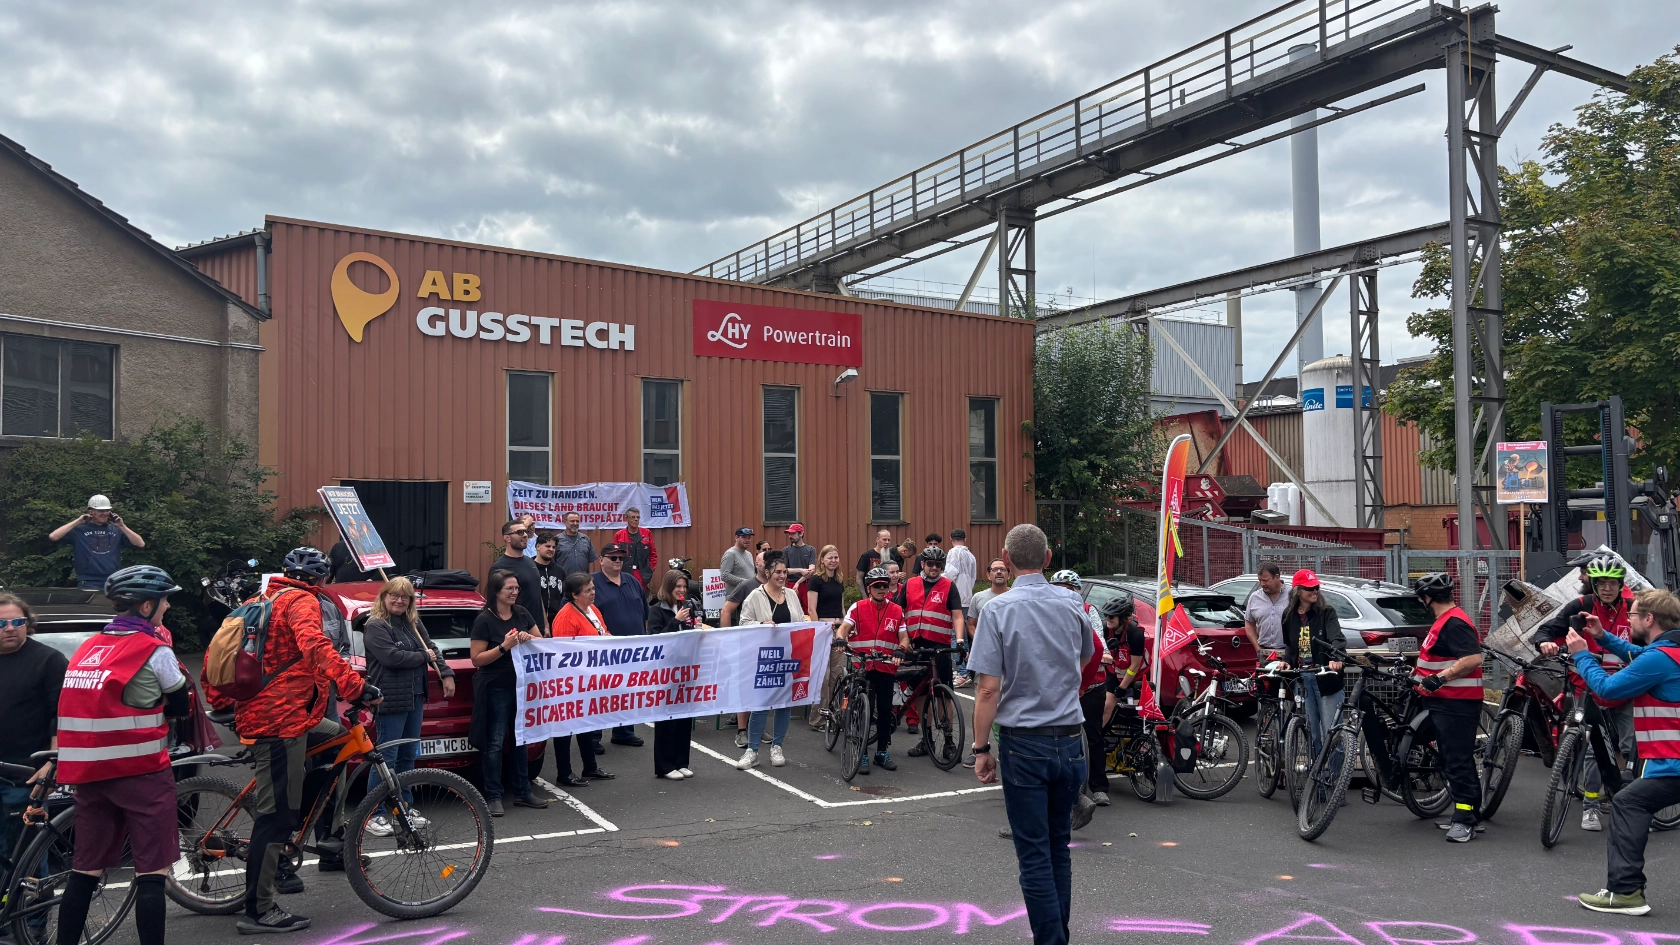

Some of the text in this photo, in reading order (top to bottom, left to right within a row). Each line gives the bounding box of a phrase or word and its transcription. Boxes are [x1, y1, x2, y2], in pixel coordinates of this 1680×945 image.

[417, 270, 482, 302] AB
[416, 306, 635, 351] GUSSTECH
[763, 325, 851, 348] Powertrain
[1303, 399, 1323, 410] Linde
[512, 488, 598, 499] ZEIT ZU HANDELN.
[336, 503, 361, 515] JETZT
[514, 500, 620, 512] DIESES LAND BRAUCHT
[523, 644, 665, 674] ZEIT ZU HANDELN.
[760, 649, 782, 659] WEIL
[758, 662, 800, 673] DAS JETZT
[525, 664, 701, 702] DIESES LAND BRAUCHT
[756, 675, 784, 687] ZÄHLT.
[525, 683, 718, 728] SICHERE ARBEITSPLÄTZE!
[421, 741, 436, 755] HH
[443, 739, 458, 753] WC
